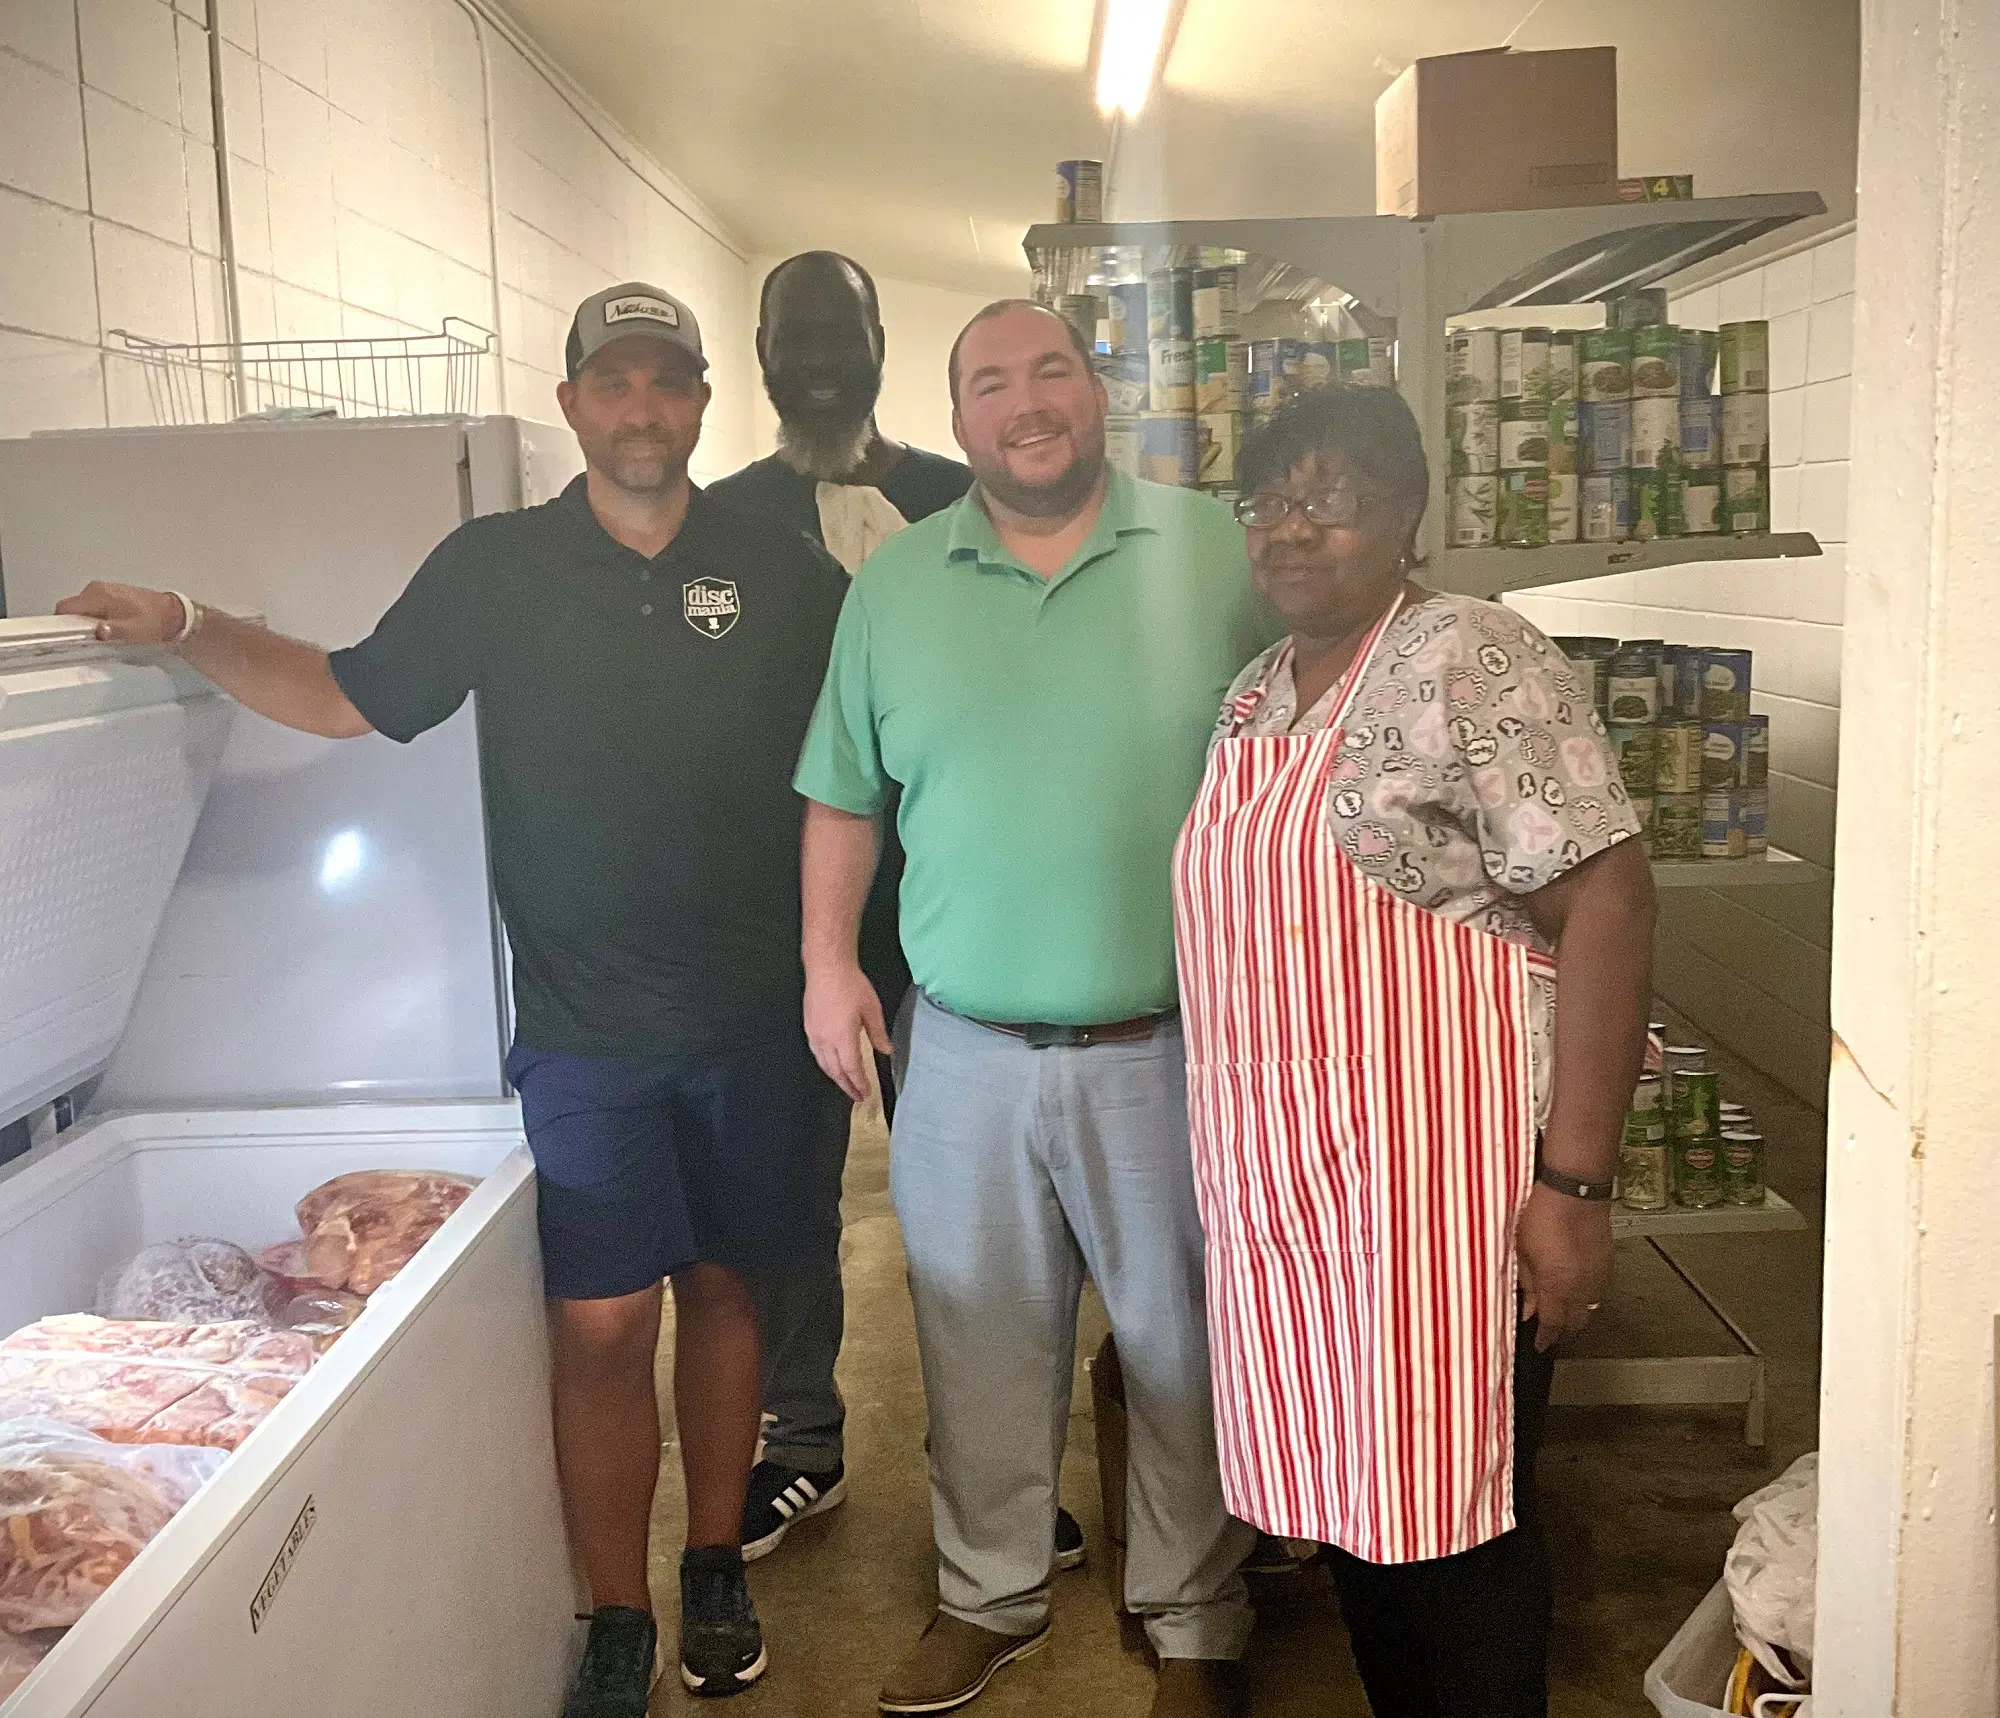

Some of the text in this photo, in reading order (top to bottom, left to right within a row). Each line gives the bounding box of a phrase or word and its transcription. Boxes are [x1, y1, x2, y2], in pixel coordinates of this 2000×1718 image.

[1653, 179, 1669, 196] 4
[688, 585, 734, 606] disc
[688, 603, 737, 617] mania
[253, 1502, 317, 1620] VEGETABLES
